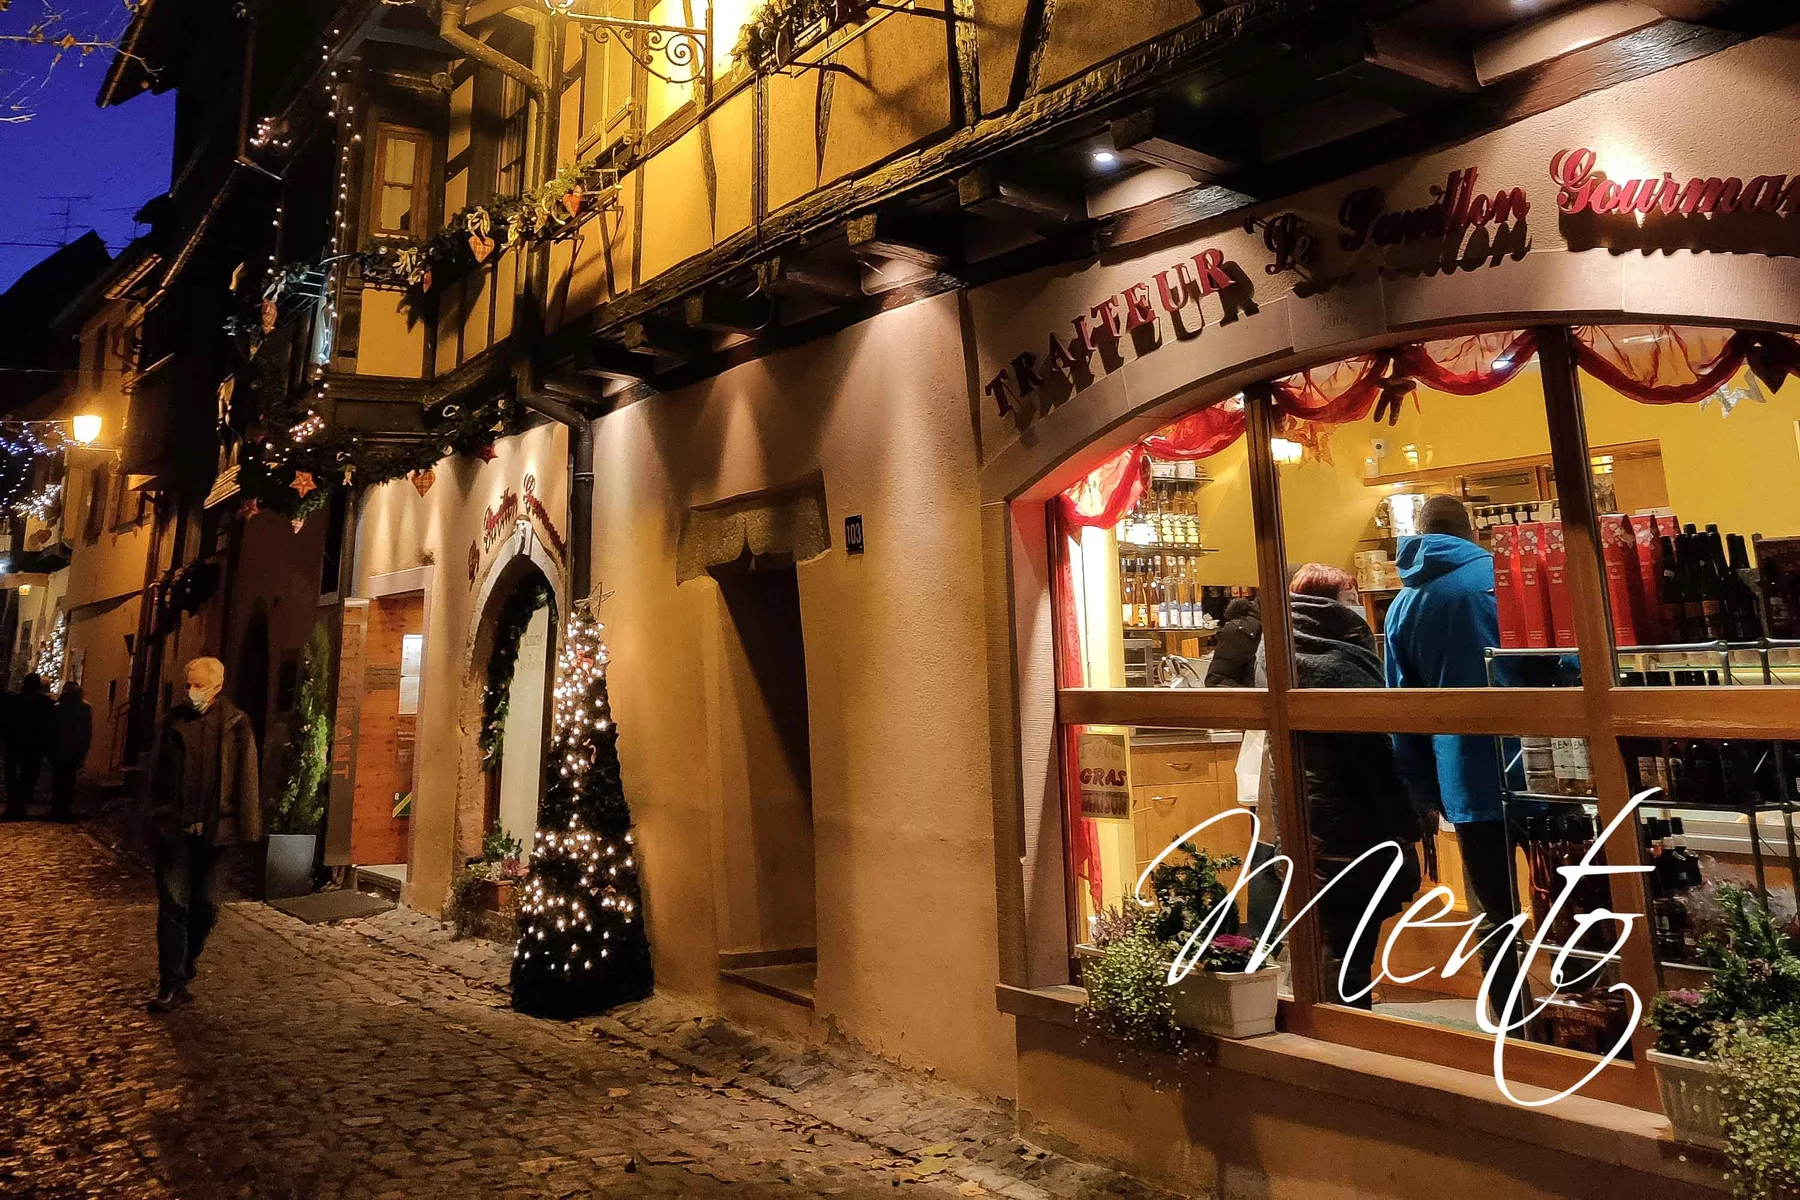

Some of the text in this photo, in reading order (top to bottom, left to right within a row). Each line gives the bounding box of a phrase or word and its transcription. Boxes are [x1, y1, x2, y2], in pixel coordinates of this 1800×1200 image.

[985, 247, 1236, 418] TRAITEUR
[846, 522, 862, 545] 103
[1080, 767, 1127, 787] GRAS
